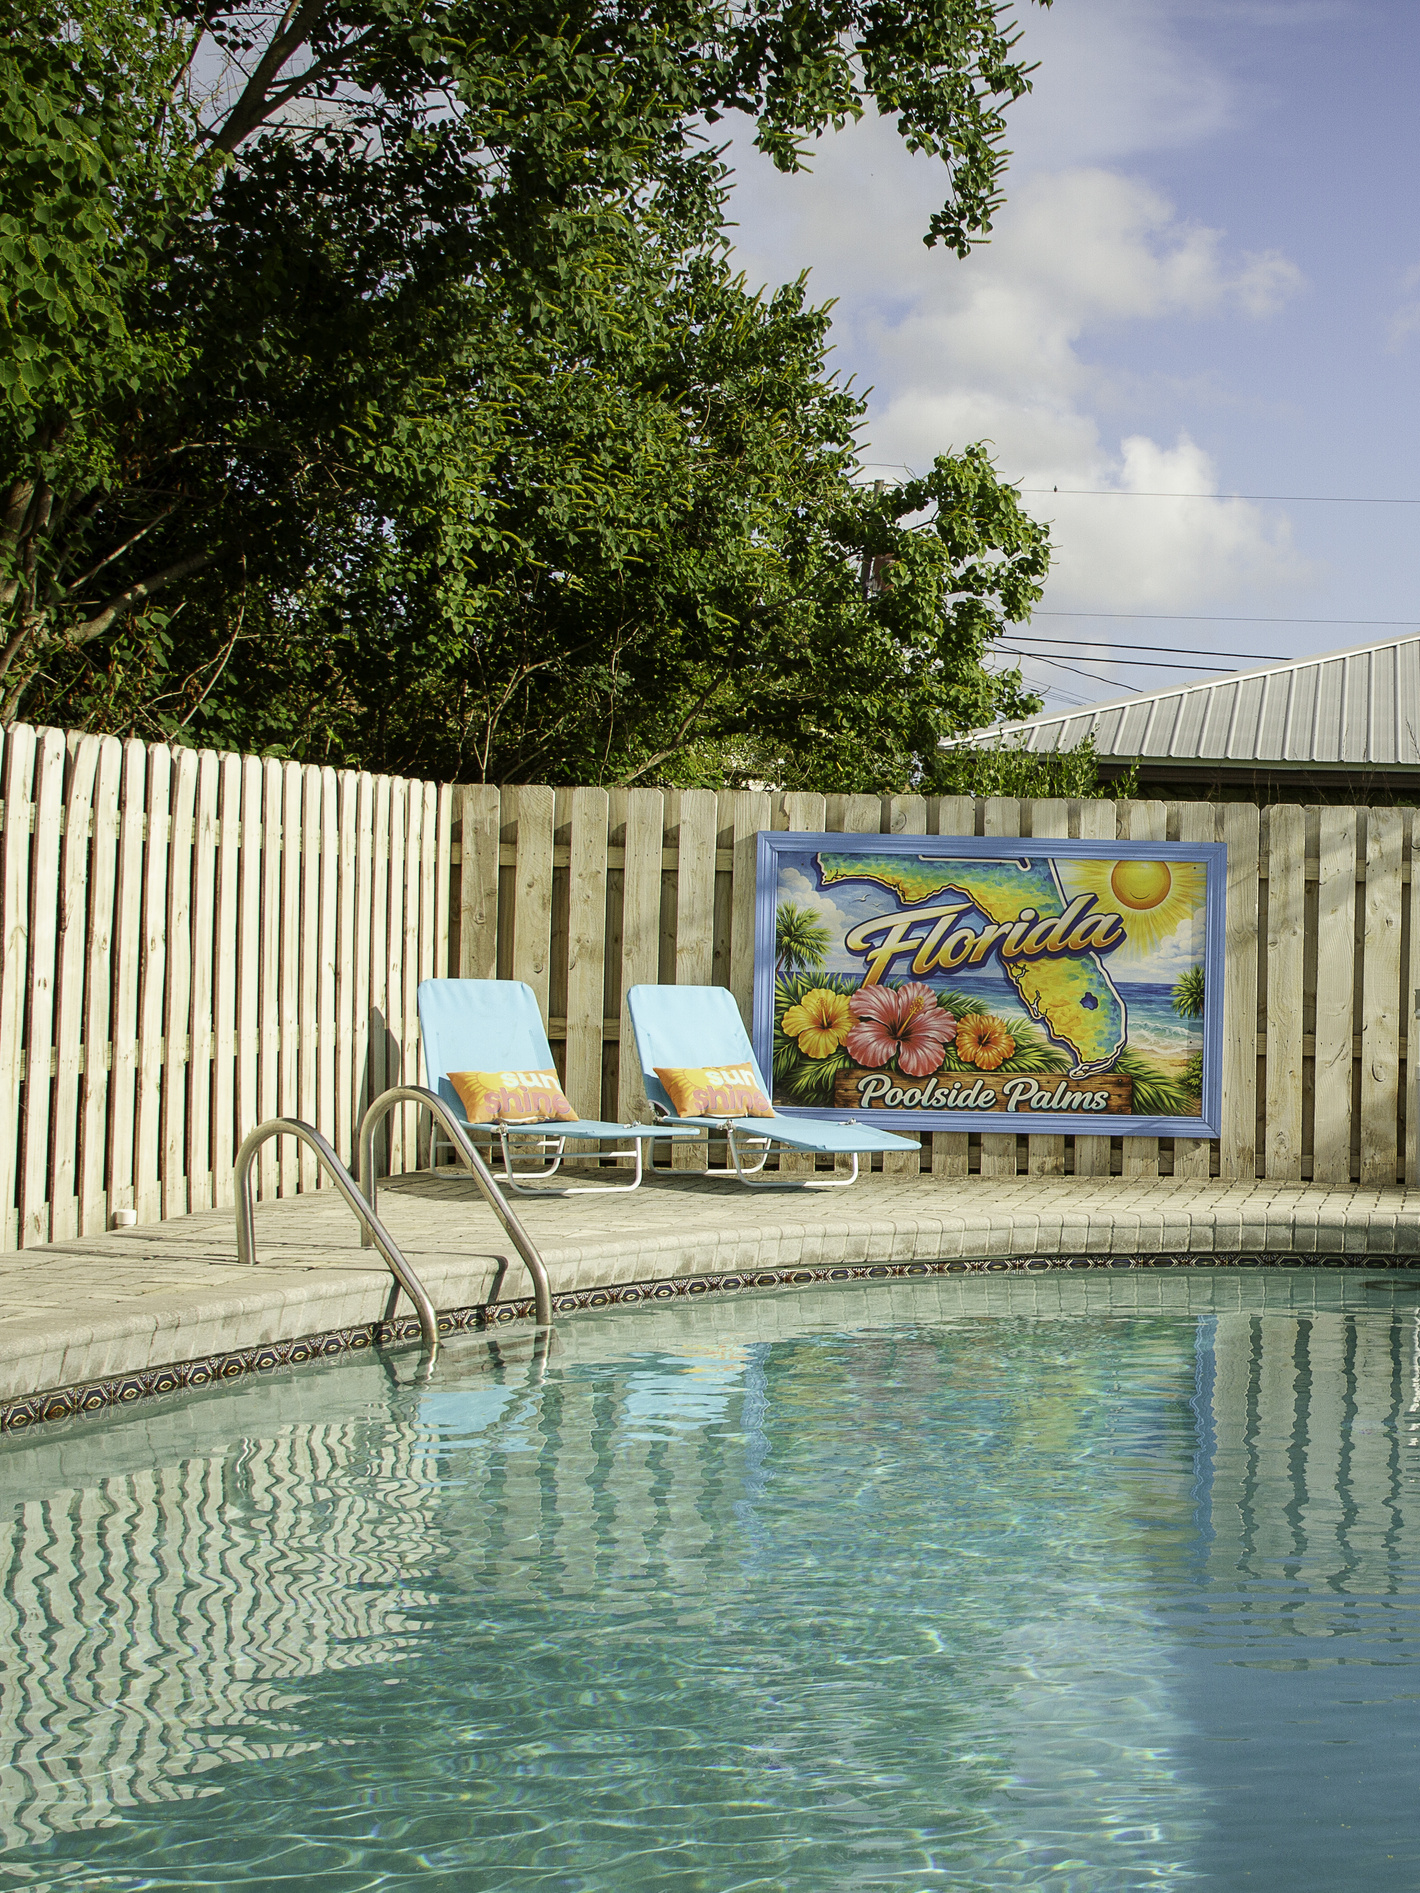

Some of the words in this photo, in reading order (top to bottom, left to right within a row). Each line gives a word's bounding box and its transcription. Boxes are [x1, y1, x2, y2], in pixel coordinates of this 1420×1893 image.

[846, 893, 1127, 990] Florida
[500, 1072, 563, 1092] sun
[705, 1069, 761, 1089] sun
[857, 1073, 996, 1109] Poolside
[1002, 1076, 1109, 1112] Palms
[484, 1086, 571, 1114] shine
[693, 1085, 770, 1111] shine
